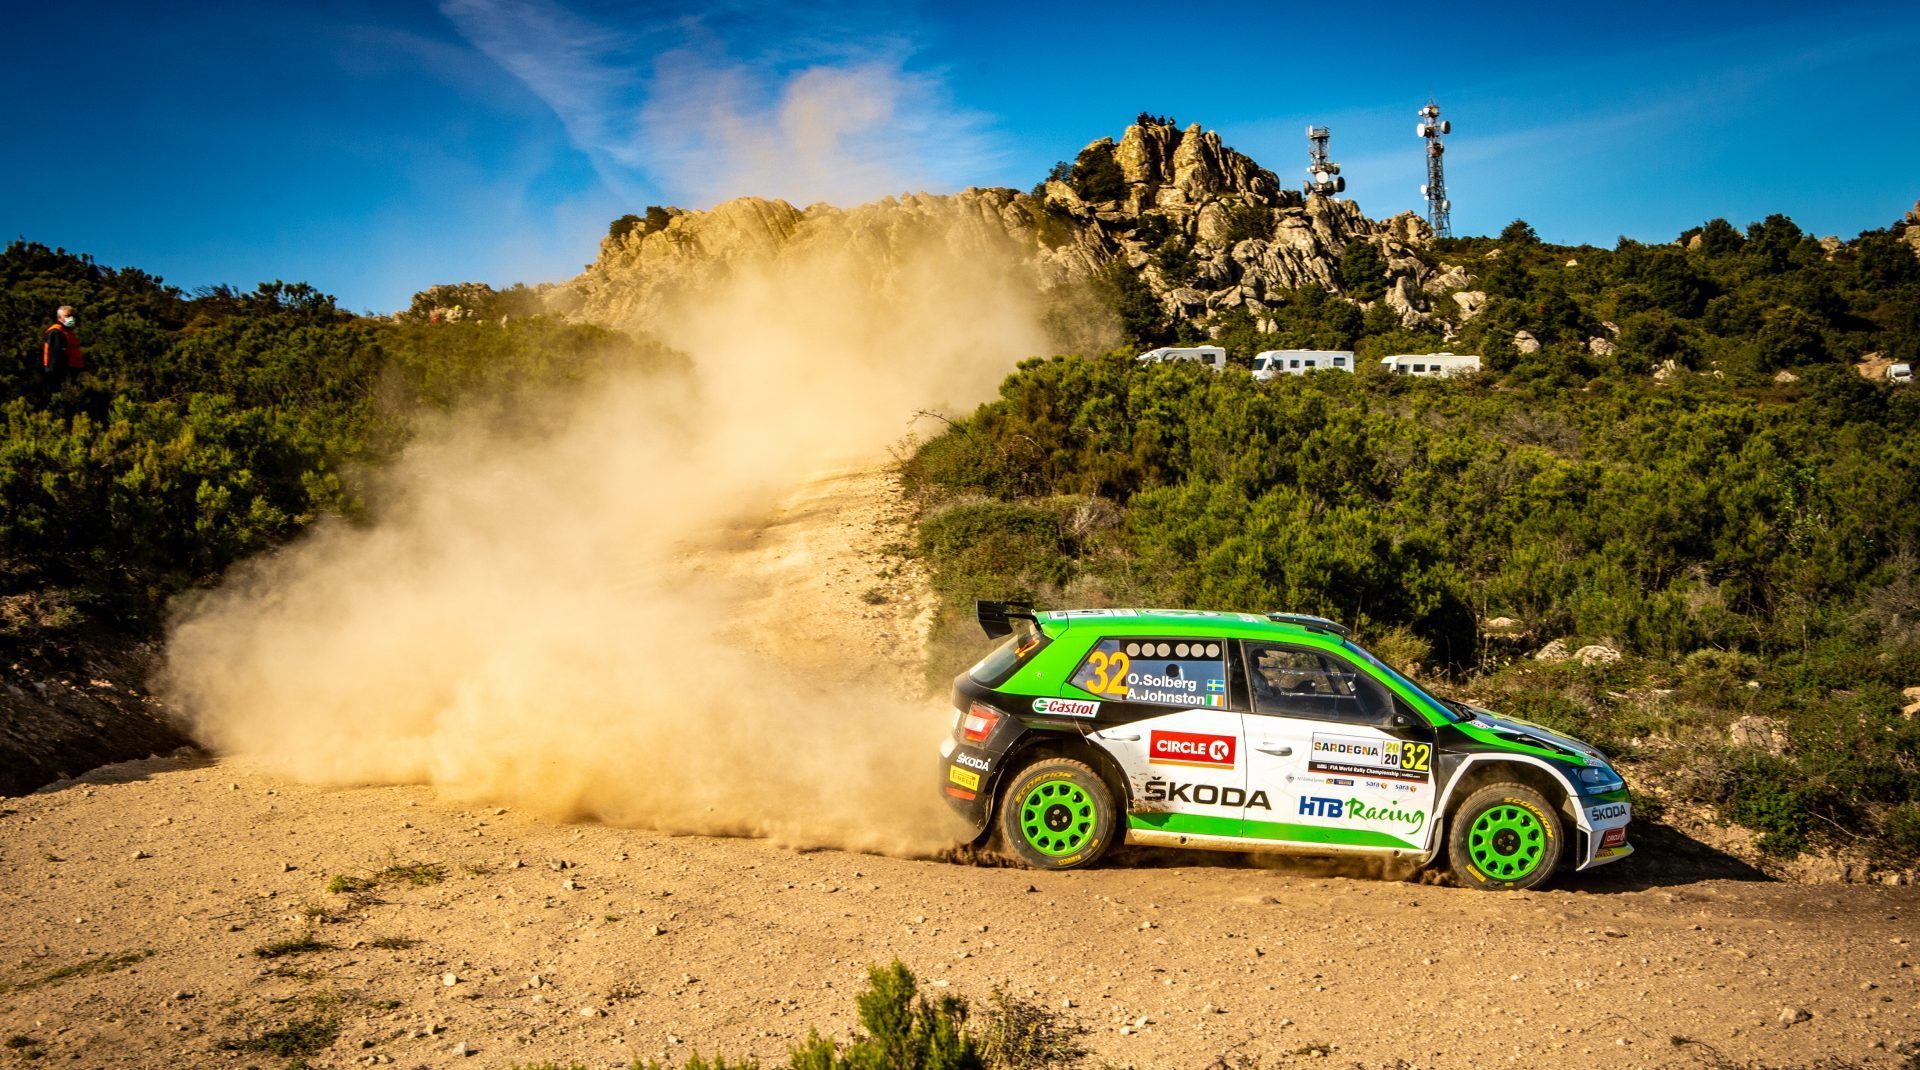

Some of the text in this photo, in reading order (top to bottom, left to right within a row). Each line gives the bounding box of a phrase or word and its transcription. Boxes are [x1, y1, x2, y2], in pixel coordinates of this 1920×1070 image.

[1086, 652, 1129, 695] 32
[1127, 673, 1197, 691] O.Solberg
[1126, 689, 1205, 705] A.Johnston
[1049, 700, 1095, 715] Castrol
[1156, 739, 1227, 759] CIRCLE K
[1314, 742, 1379, 757] SARDEGNA
[1385, 742, 1399, 753] 20
[956, 752, 989, 771] ŠKODA
[1384, 754, 1398, 765] 20
[1401, 743, 1430, 771] 32
[1366, 769, 1400, 777] Championship
[1015, 771, 1074, 804] SCORPION
[1366, 780, 1380, 788] sara
[1144, 776, 1272, 811] ŠKODA
[1299, 795, 1425, 835] HTB Racing
[1503, 797, 1554, 838] SCORPION
[1591, 804, 1627, 821] ŠKODA
